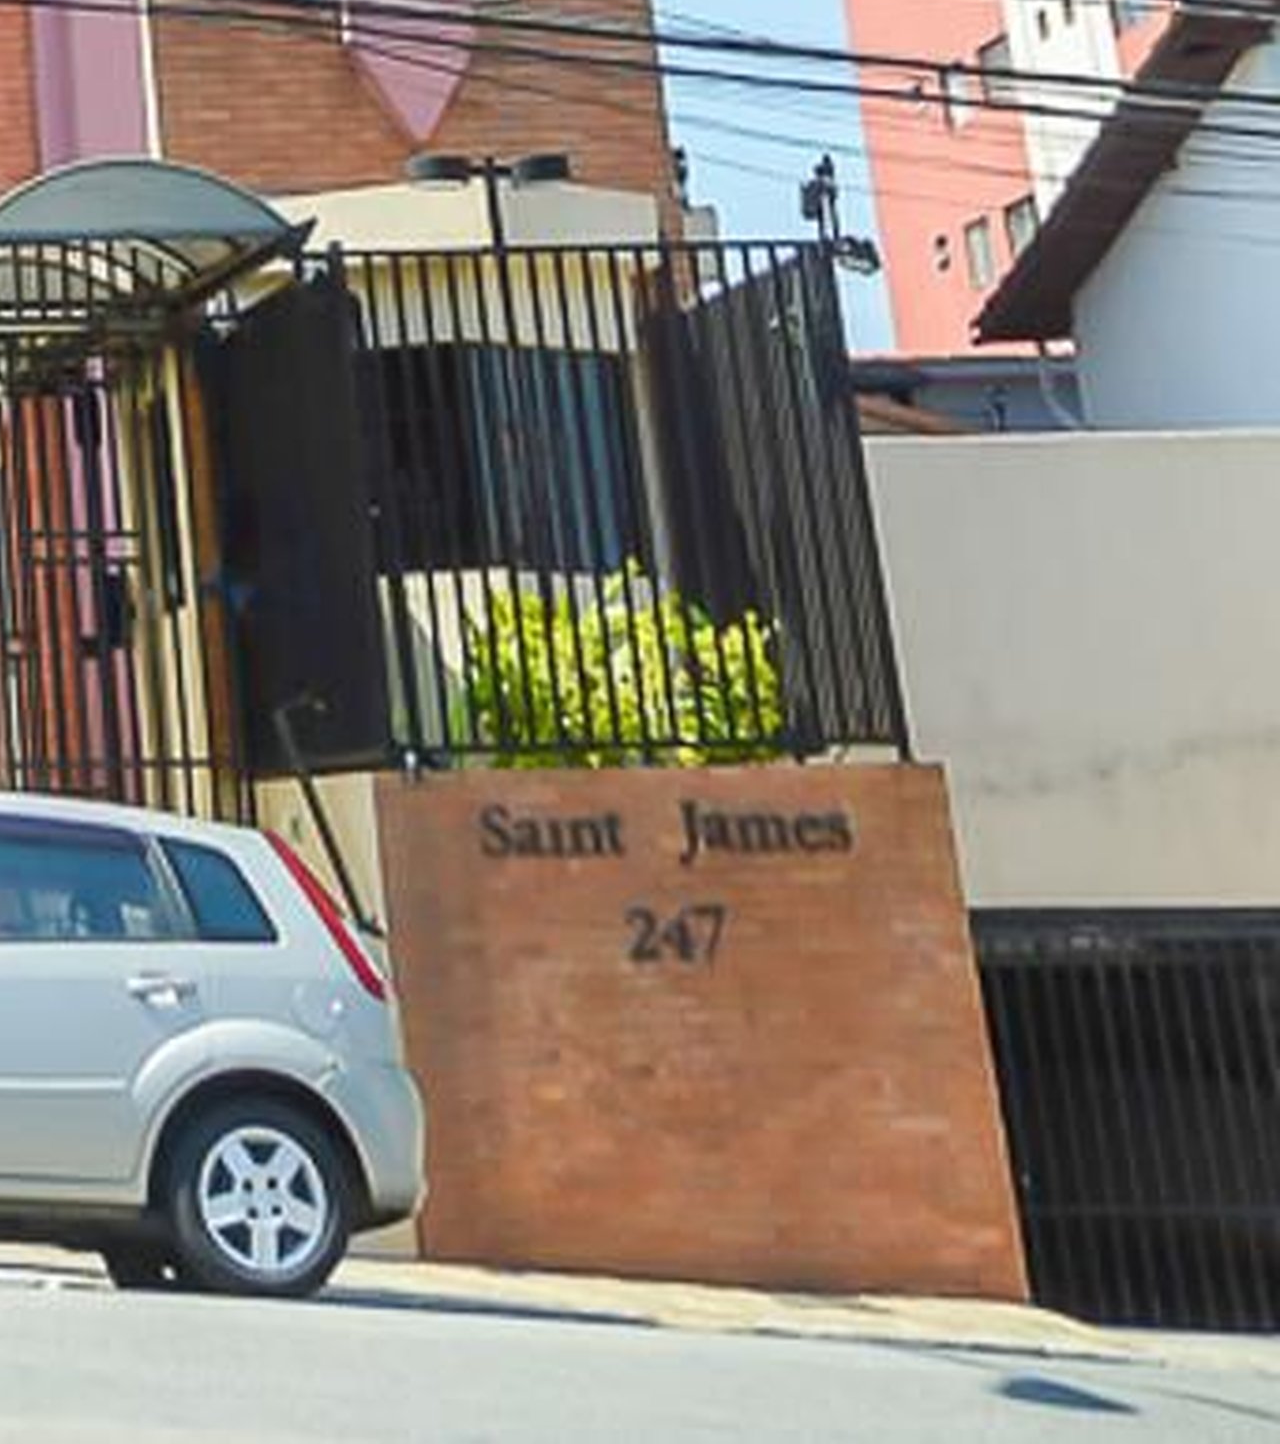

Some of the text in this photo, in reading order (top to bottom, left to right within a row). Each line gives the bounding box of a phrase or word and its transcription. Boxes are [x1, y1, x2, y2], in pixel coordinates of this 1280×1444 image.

[478, 800, 853, 866] Saint James
[624, 904, 728, 967] 247
